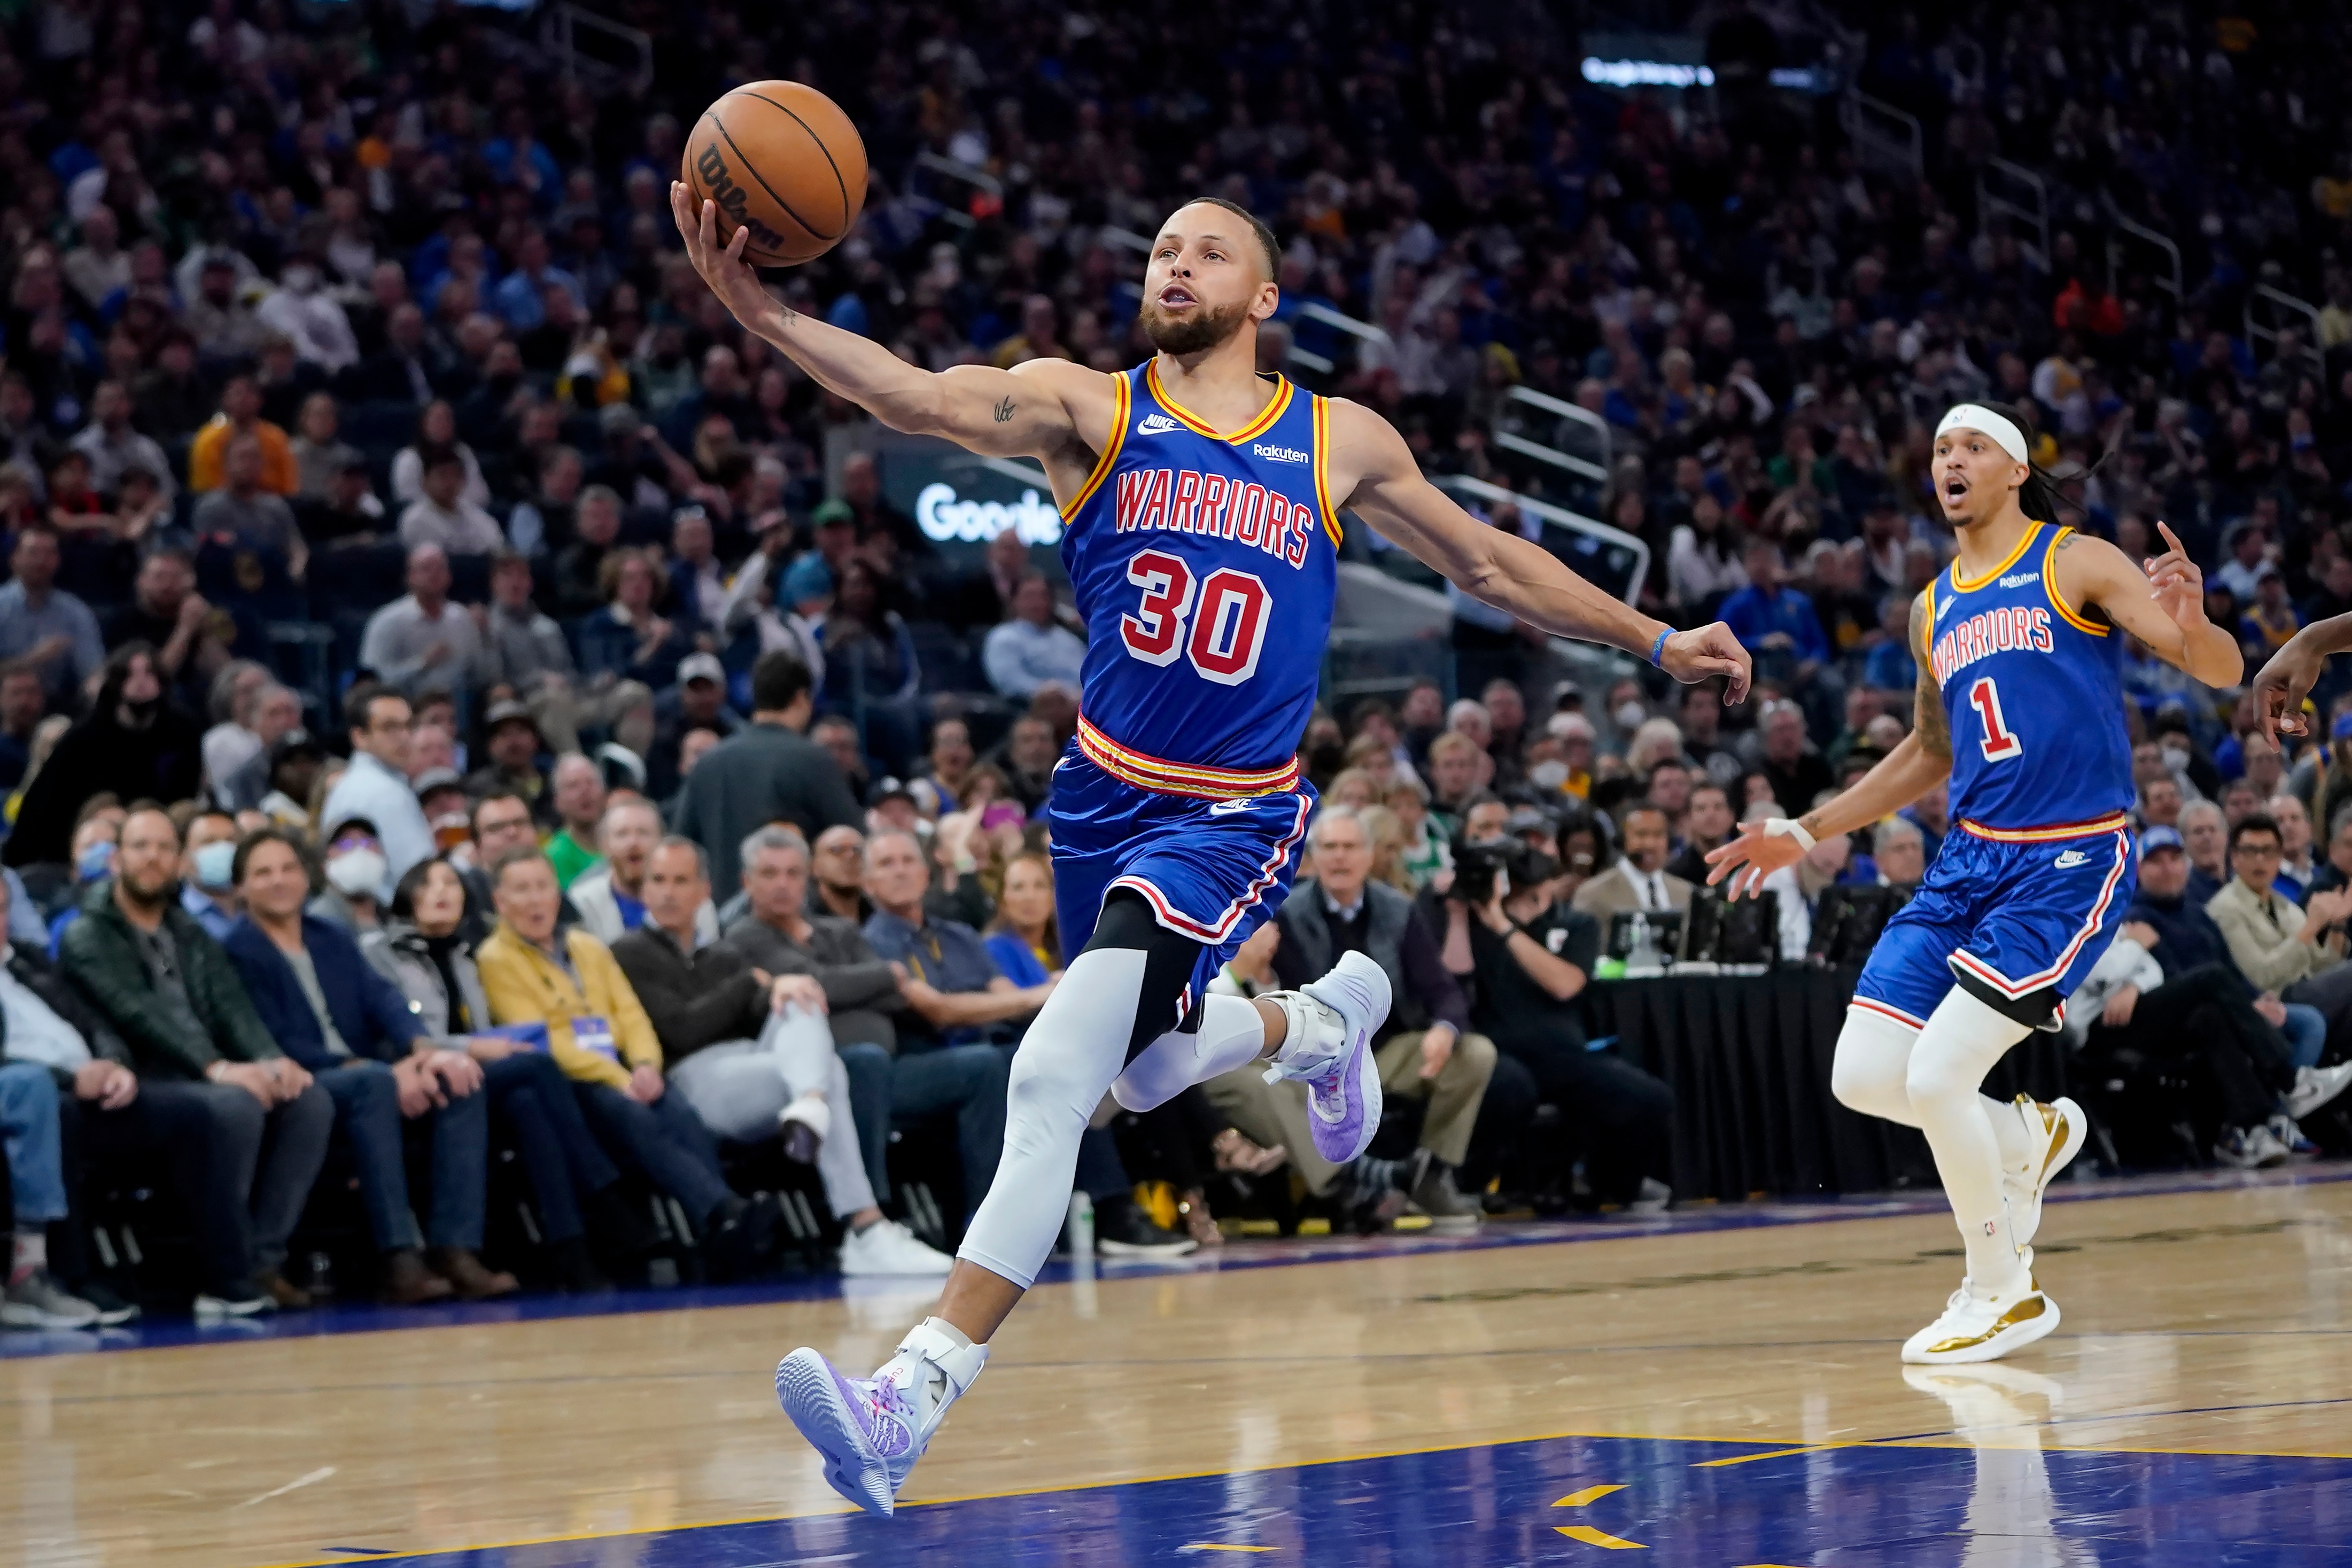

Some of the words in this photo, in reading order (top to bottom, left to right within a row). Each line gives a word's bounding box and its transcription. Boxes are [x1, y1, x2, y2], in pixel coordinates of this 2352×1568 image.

[697, 142, 785, 251] Wilson
[1144, 413, 1177, 429] NIKE
[1254, 444, 1309, 464] Rakuten
[1116, 469, 1314, 570] WARRIORS
[1120, 548, 1273, 686] 30
[2000, 572, 2039, 588] Rakuten
[1932, 607, 2054, 692] WARRIORS
[1969, 677, 2023, 763] 1
[2060, 850, 2085, 862] NIKE
